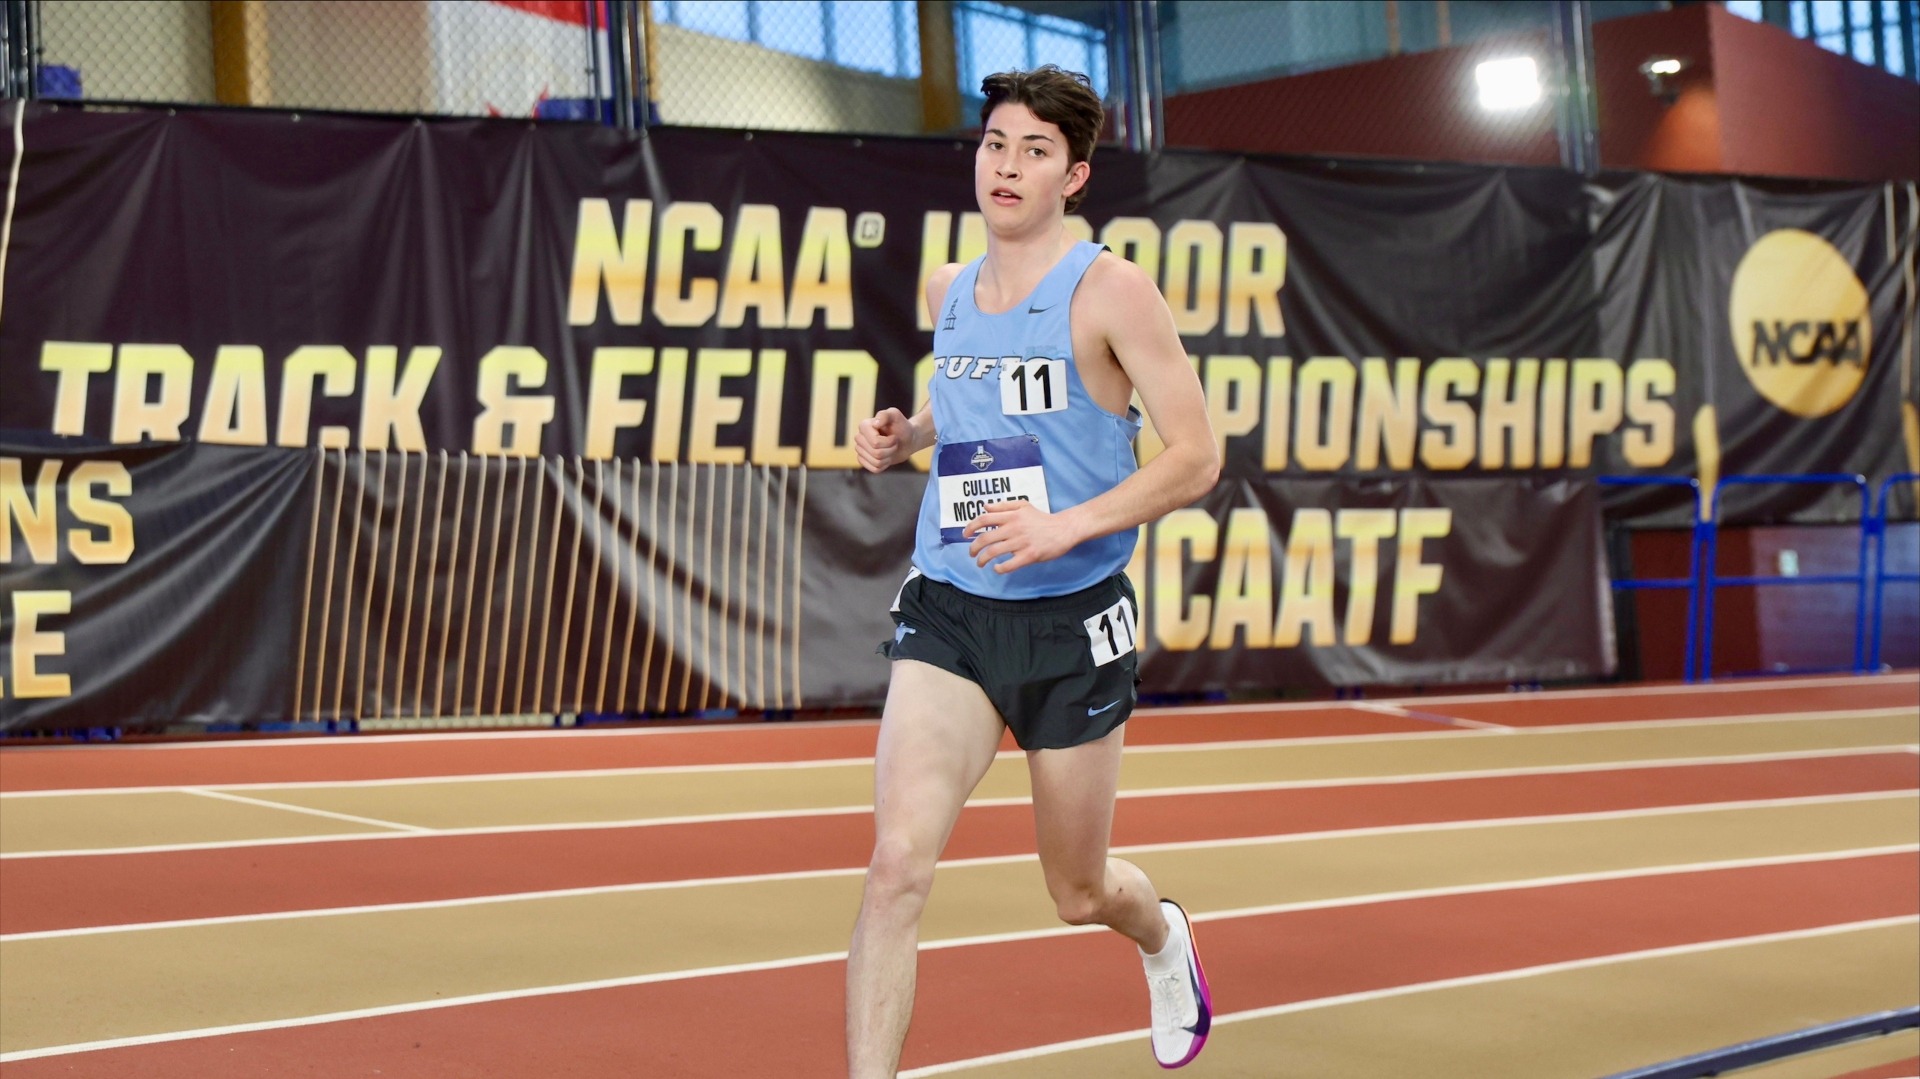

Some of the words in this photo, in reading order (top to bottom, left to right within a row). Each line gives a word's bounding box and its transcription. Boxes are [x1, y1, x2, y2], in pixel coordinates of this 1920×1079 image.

[1752, 318, 1865, 368] NCAA
[40, 341, 442, 452] TRACK
[472, 345, 556, 457] &
[584, 346, 879, 468] FIELD
[1011, 364, 1052, 411] 11
[962, 476, 1012, 498] CULLEN
[1098, 604, 1134, 656] 11
